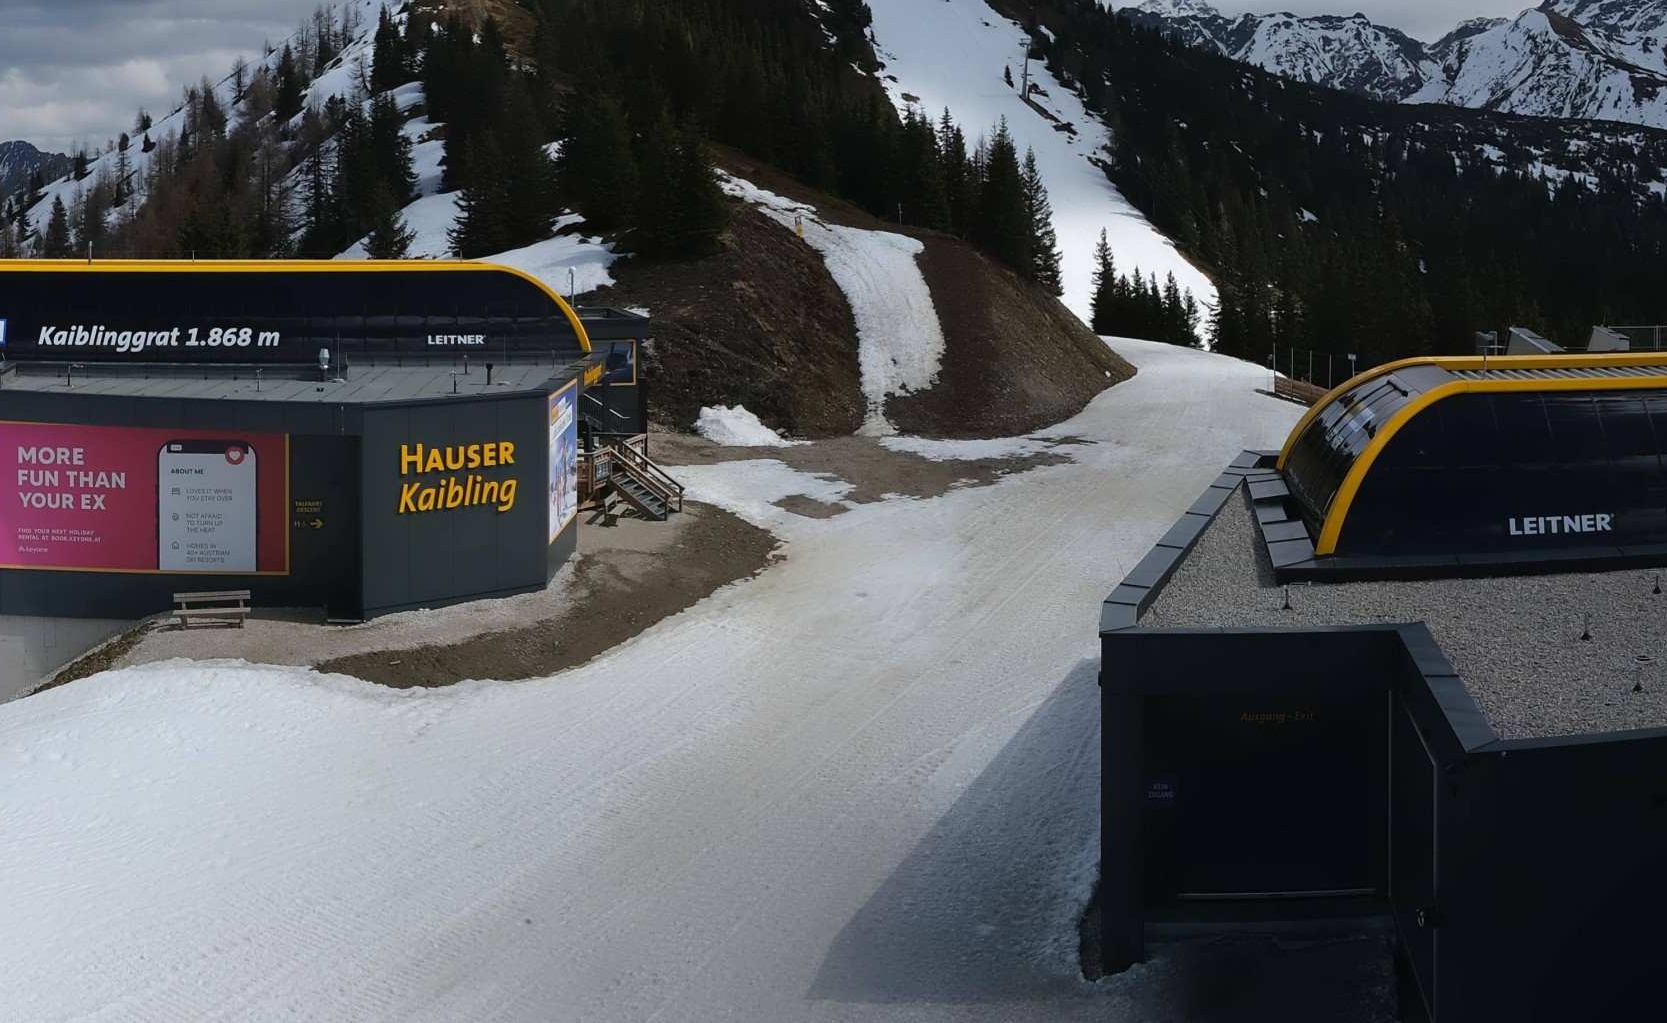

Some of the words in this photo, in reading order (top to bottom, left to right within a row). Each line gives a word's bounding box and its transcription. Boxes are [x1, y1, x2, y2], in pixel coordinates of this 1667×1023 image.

[38, 325, 180, 352] Kaiblinggrat
[185, 327, 252, 347] 1.868
[258, 331, 280, 346] m
[17, 446, 84, 465] MORE
[400, 442, 515, 474] HAUSER
[18, 470, 59, 487] FUN
[66, 471, 126, 489] THAN
[18, 493, 74, 510] YOUR
[81, 494, 106, 510] EX
[398, 475, 517, 514] Kaibling
[1509, 513, 1612, 535] LEITNER
[26, 545, 48, 553] keyone
[1240, 712, 1286, 724] Ausgang
[1295, 710, 1315, 719] Exit
